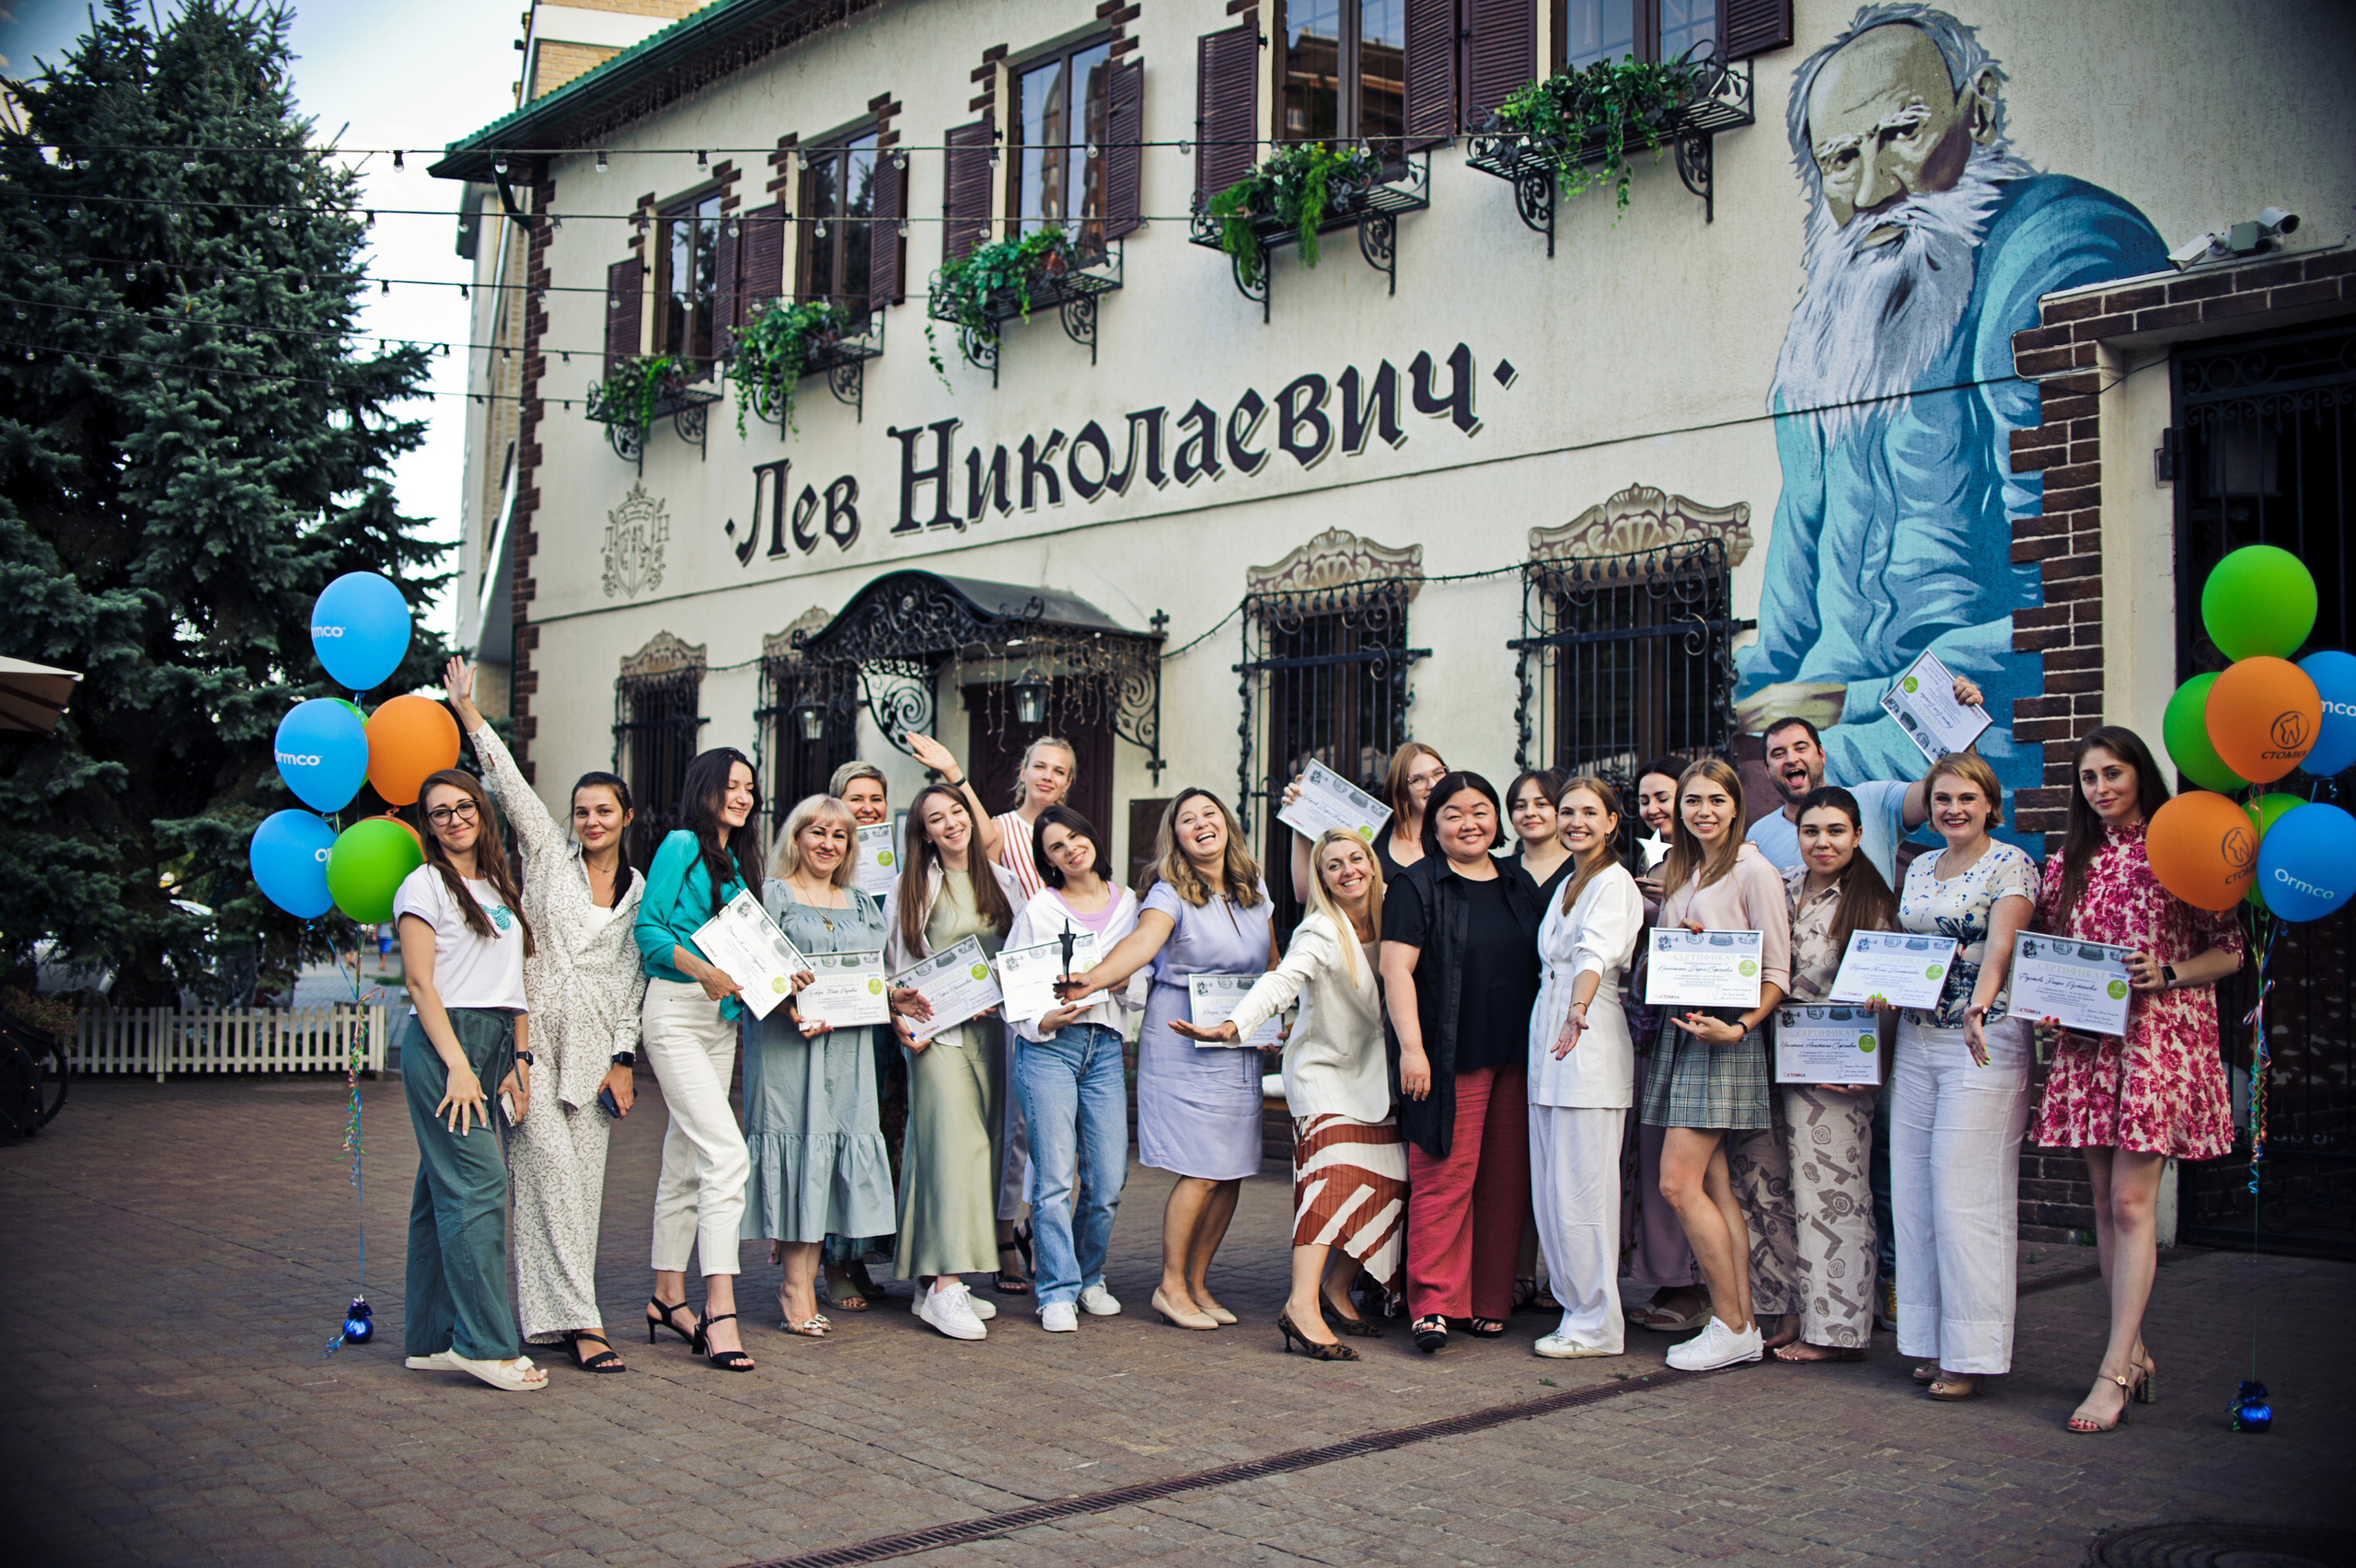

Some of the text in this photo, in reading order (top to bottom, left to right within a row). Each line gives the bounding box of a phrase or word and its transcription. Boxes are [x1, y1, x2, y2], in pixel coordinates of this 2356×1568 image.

[735, 342, 1484, 567] Лев Николаевич
[2320, 700, 2356, 717] mco
[2274, 869, 2334, 899] Ormco
